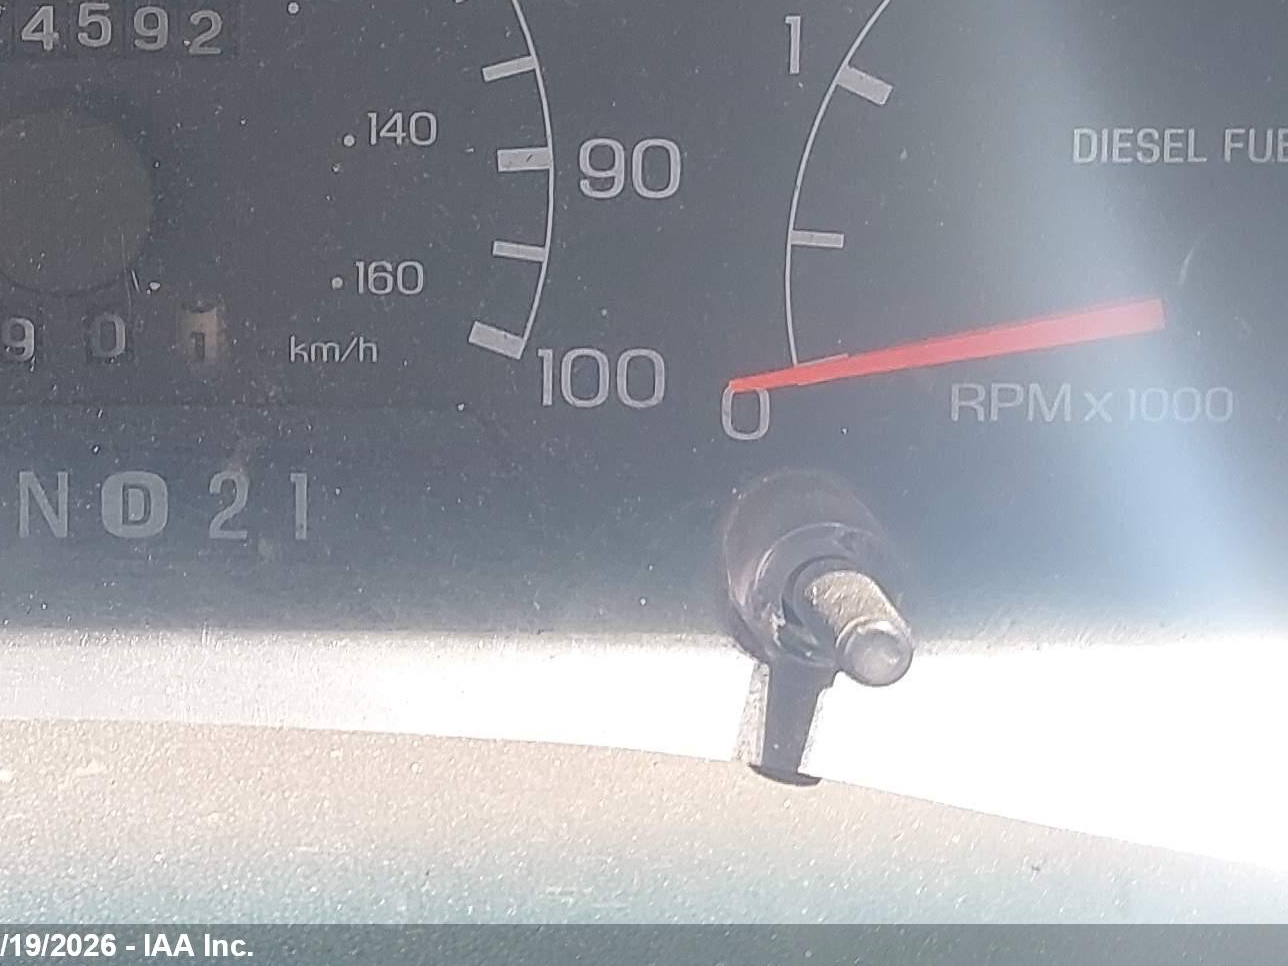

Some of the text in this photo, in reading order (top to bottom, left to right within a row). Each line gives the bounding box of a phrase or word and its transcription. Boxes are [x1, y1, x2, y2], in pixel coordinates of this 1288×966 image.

[785, 15, 802, 74] 1
[367, 112, 439, 146] 140
[1072, 127, 1208, 163] DIESEL
[578, 138, 682, 199] 90
[355, 261, 425, 295] 160
[289, 335, 379, 364] km/h
[538, 348, 667, 409] 100
[721, 385, 770, 440] 0
[950, 383, 1072, 422] RPM
[1127, 386, 1235, 422] 1000
[18, 471, 69, 538] N
[208, 471, 250, 540] 2
